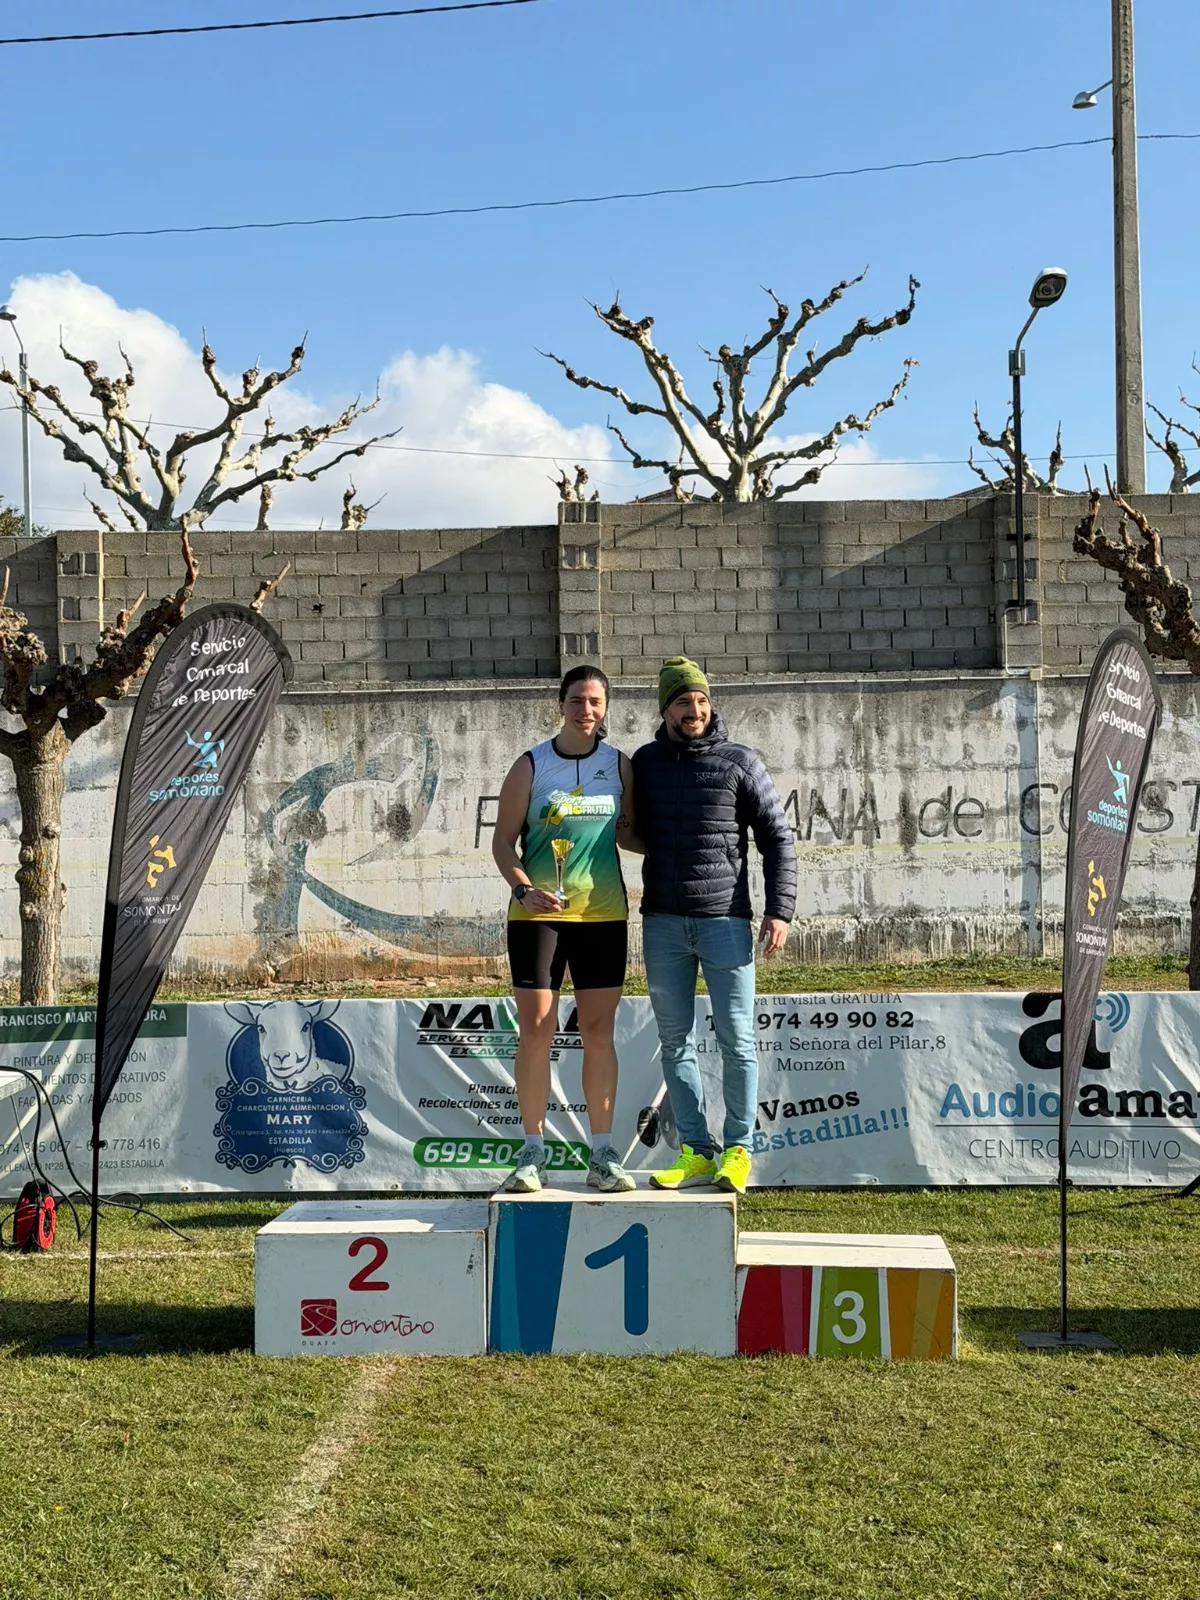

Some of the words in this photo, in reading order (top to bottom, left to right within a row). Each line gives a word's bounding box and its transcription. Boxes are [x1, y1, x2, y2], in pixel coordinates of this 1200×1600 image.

[1109, 660, 1140, 683] Srvicio
[194, 686, 257, 704] Deportes
[1109, 711, 1146, 740] Deportes
[918, 785, 985, 838] de
[1099, 800, 1128, 818] deportes
[1087, 810, 1128, 833] somontan
[774, 995, 786, 1006] tu
[791, 993, 826, 1006] visita
[831, 993, 902, 1004] GRATUITA
[758, 1013, 801, 1029] 974
[810, 1012, 838, 1029] 49
[847, 1011, 876, 1028] 90
[886, 1011, 914, 1028] 82
[419, 1034, 504, 1044] SERVICIOS
[790, 1036, 850, 1051] Señora
[857, 1035, 882, 1050] del
[889, 1035, 947, 1052] Pilar,8
[14, 1055, 61, 1067] PINTURA
[65, 1054, 72, 1064] Y
[777, 1057, 845, 1072] Monzón
[77, 1094, 85, 1103] Y
[290, 1103, 345, 1111] ALIMENTACION
[418, 1098, 500, 1109] Recolecciones
[504, 1101, 518, 1110] de
[560, 1103, 588, 1112] seco
[940, 1083, 1061, 1118] Audio
[1078, 1083, 1200, 1118] ama
[477, 1116, 484, 1126] y
[752, 1106, 910, 1154] Estadilla!!!
[113, 1139, 135, 1150] 778
[138, 1138, 161, 1150] 416
[268, 1137, 313, 1145] ESTADILLA
[969, 1139, 1060, 1158] CENTRO
[1069, 1139, 1181, 1159] AUDITIVO
[423, 1142, 473, 1163] 699
[121, 1160, 165, 1168] ESTADILLA
[348, 1236, 390, 1291] 2
[584, 1222, 649, 1336] 1
[832, 1290, 867, 1344] 3
